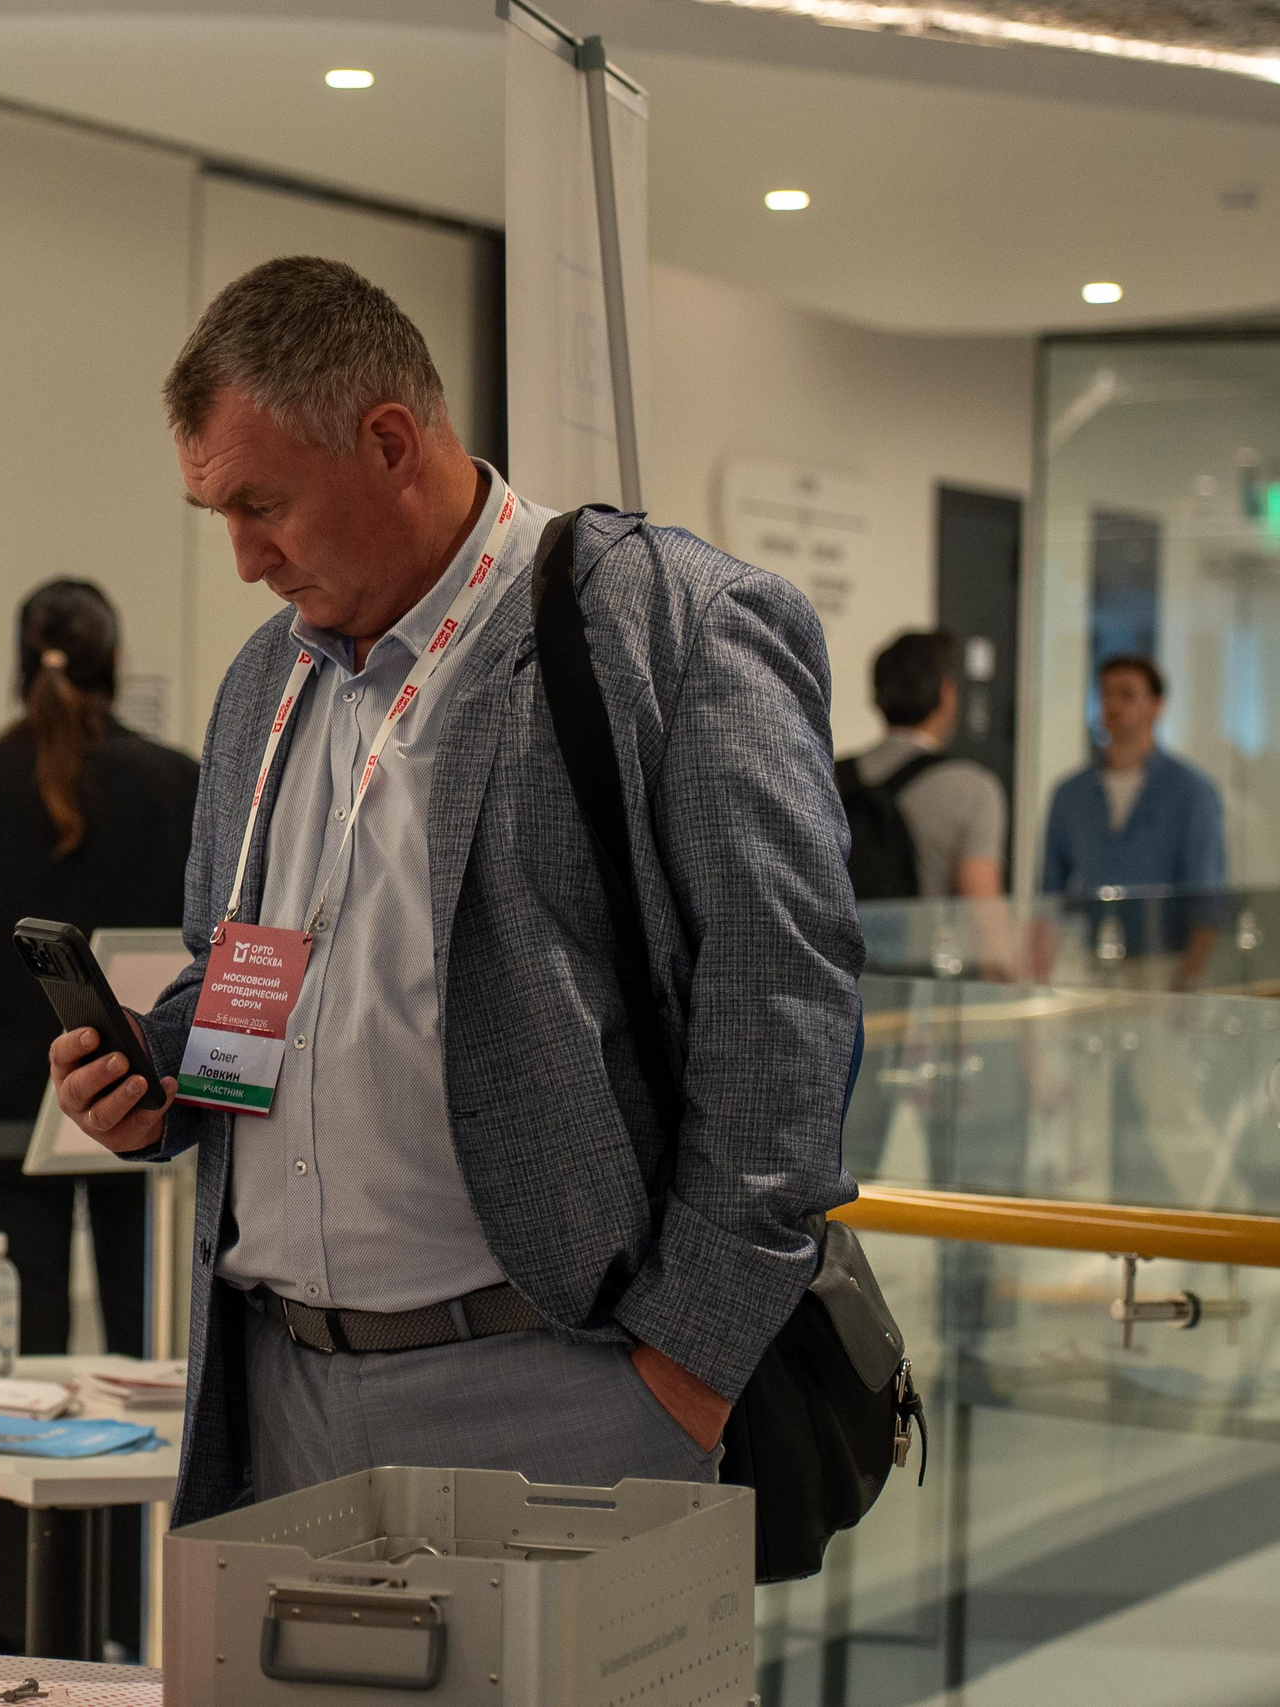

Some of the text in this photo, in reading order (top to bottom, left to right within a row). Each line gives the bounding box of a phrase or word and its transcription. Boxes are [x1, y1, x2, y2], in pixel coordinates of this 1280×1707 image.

[468, 564, 483, 588] МОСКВА
[477, 568, 488, 584] ОРТО
[428, 629, 446, 653] МОСКВА
[439, 632, 451, 649] ОРТО
[388, 695, 405, 720] МОСКВА
[397, 698, 410, 714] ОРТО
[251, 944, 274, 956] ОРТО
[248, 955, 283, 968] МОСКВА
[222, 972, 281, 988] МОСКОВСКИЙ
[211, 982, 288, 1001] ОРТОПЕДИЧЕСКИЙ
[230, 998, 262, 1010] ФОРУМ
[216, 1013, 228, 1022] 5-6
[250, 1018, 269, 1029] 2026
[210, 1049, 239, 1064] Олег
[197, 1064, 241, 1082] Ловкин
